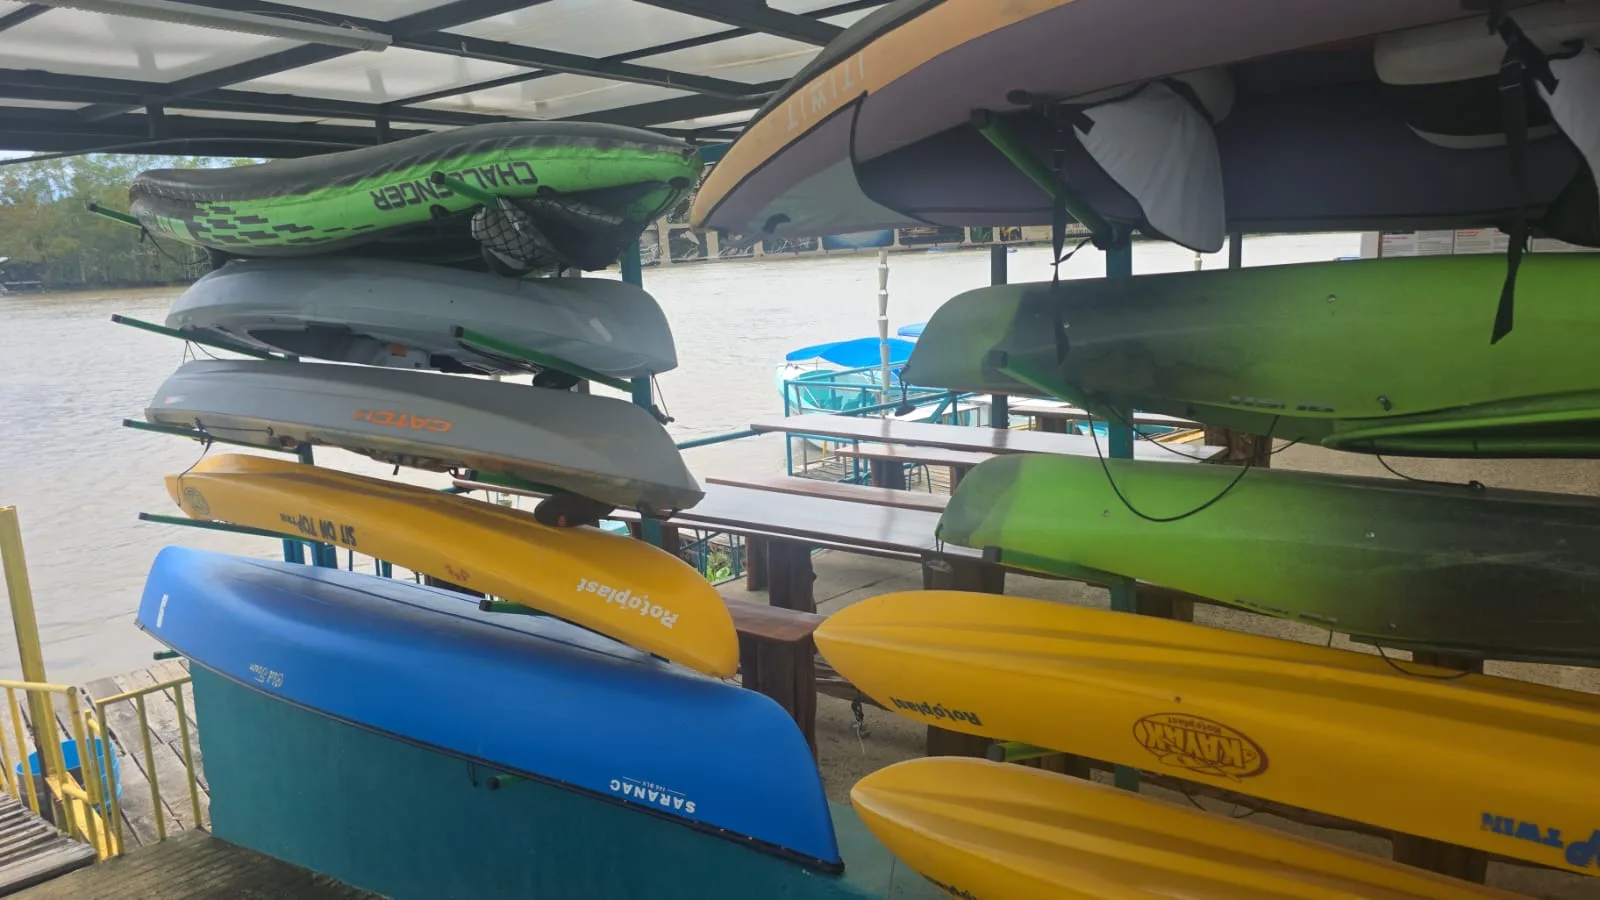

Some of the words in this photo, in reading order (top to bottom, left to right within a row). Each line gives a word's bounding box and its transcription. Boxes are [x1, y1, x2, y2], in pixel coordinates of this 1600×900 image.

[354, 408, 453, 432] CATCH
[576, 577, 679, 629] Rotoplast
[890, 696, 984, 726] Rotoplast
[609, 779, 696, 814] SARANAC
[1481, 812, 1564, 848] TWIN
